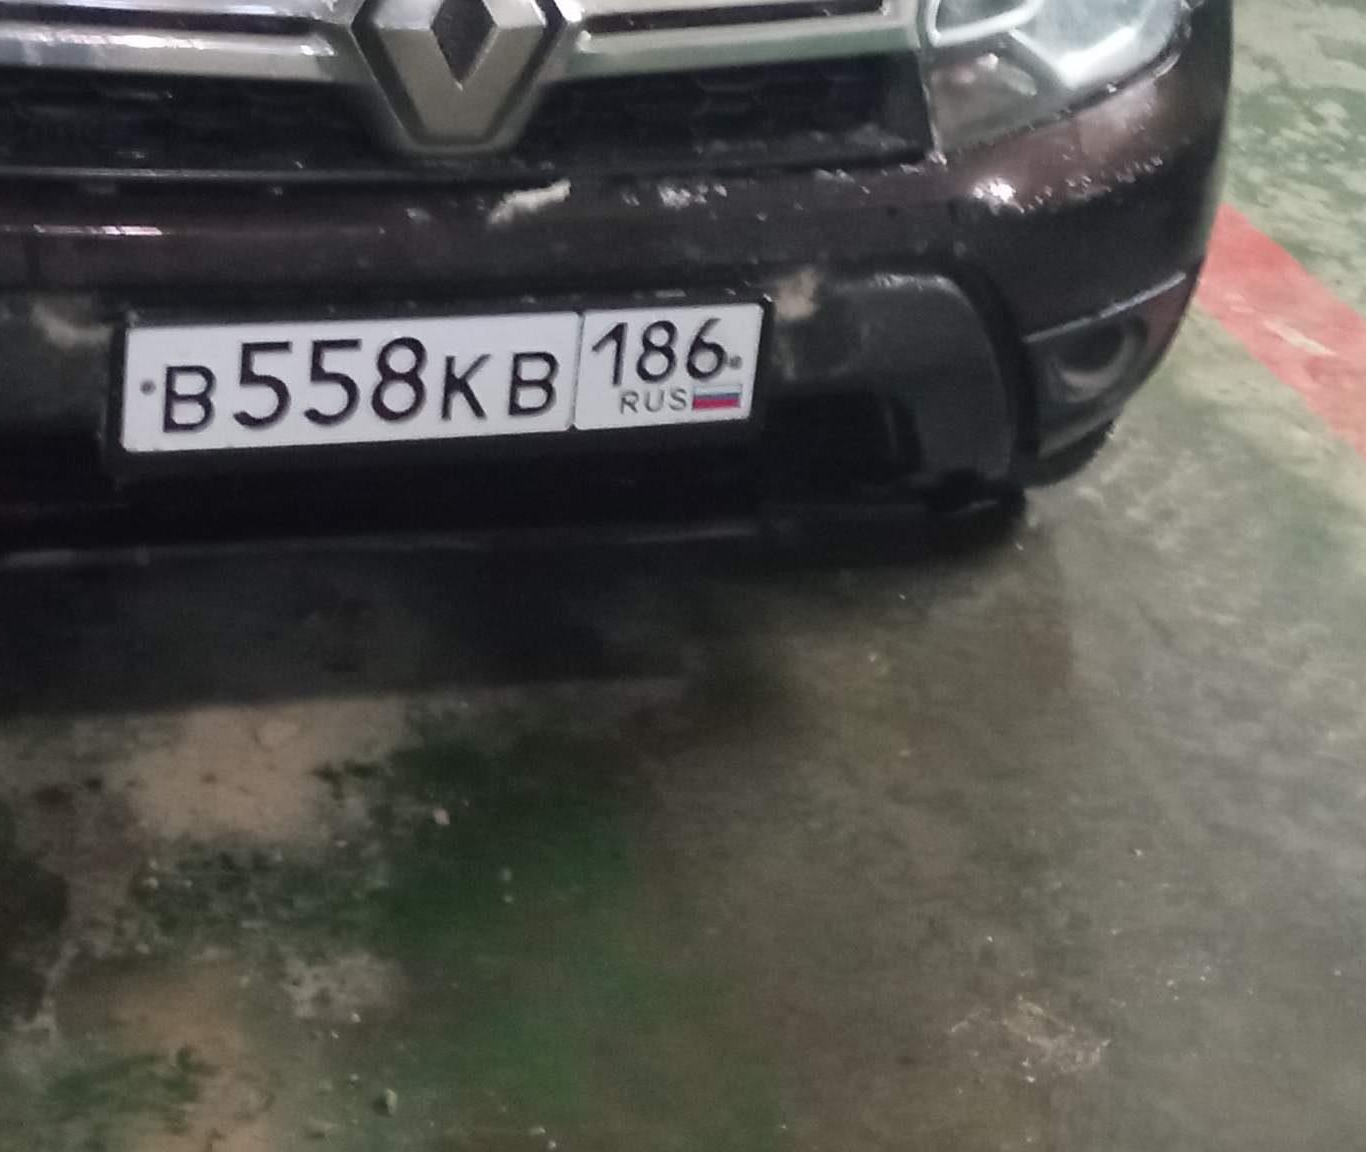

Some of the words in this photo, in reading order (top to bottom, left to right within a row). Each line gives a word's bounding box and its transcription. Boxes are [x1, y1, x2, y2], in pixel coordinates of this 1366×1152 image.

[163, 337, 559, 433] В558КВ
[591, 318, 728, 387] 186
[619, 389, 688, 415] RUS
